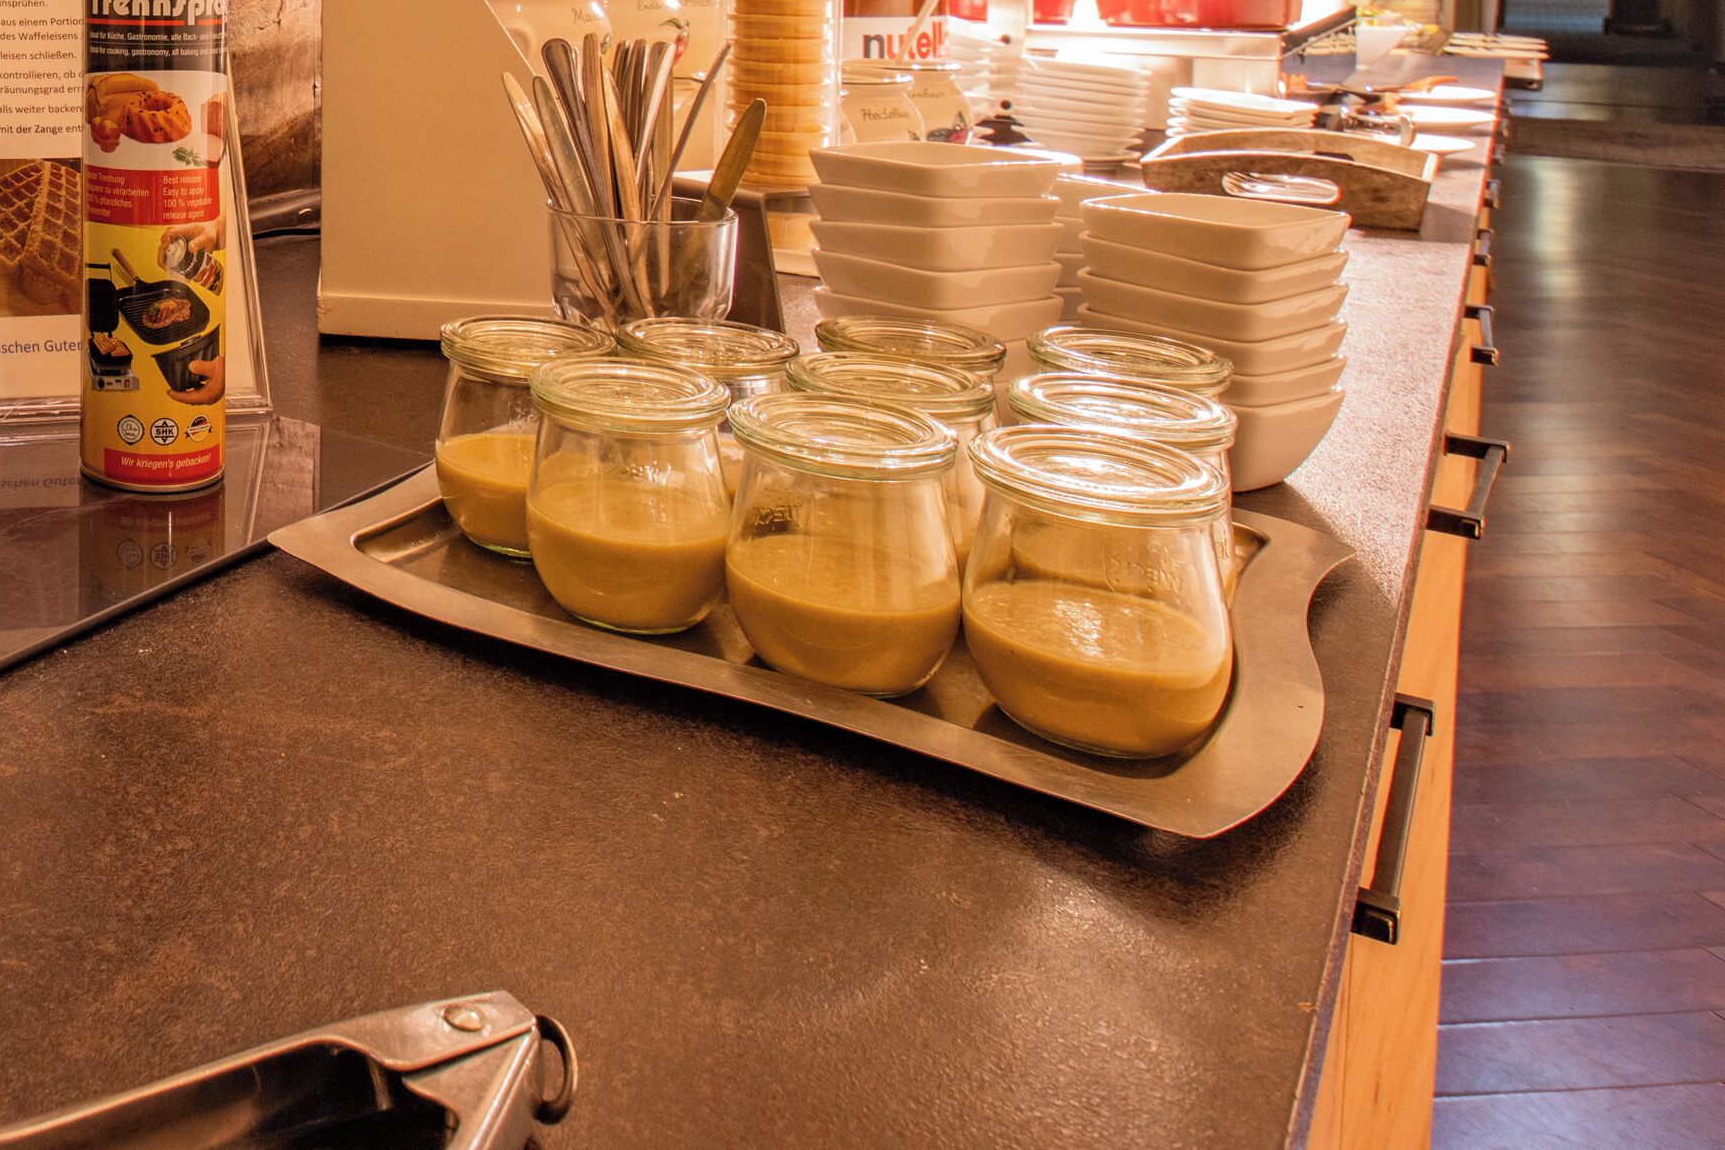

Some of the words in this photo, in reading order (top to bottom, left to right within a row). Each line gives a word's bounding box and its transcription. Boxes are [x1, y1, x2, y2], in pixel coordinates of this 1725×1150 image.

[18, 18, 48, 26] einem
[0, 32, 15, 41] des
[18, 31, 78, 41] Waffeleisens
[107, 32, 126, 40] Küche,
[127, 33, 170, 42] Gastronomie,
[863, 21, 950, 59] nutell
[29, 50, 77, 60] schließen.
[107, 47, 130, 56] cooking,
[132, 48, 170, 57] gastronomy,
[180, 47, 198, 56] baking
[63, 70, 76, 79] ob
[15, 105, 45, 114] weiter
[16, 124, 32, 134] der
[34, 125, 63, 136] Zange
[65, 124, 82, 133] ent
[163, 175, 178, 184] Best
[180, 175, 202, 184] release
[113, 187, 149, 197] verarbeiten
[163, 187, 179, 197] Easy
[189, 186, 205, 196] apply
[163, 199, 176, 207] 100
[163, 211, 186, 220] release
[188, 209, 204, 220] agent
[155, 428, 174, 436] SHK
[121, 456, 134, 467] Wir
[136, 458, 174, 470] kriegen's
[176, 453, 211, 469] gebacken!
